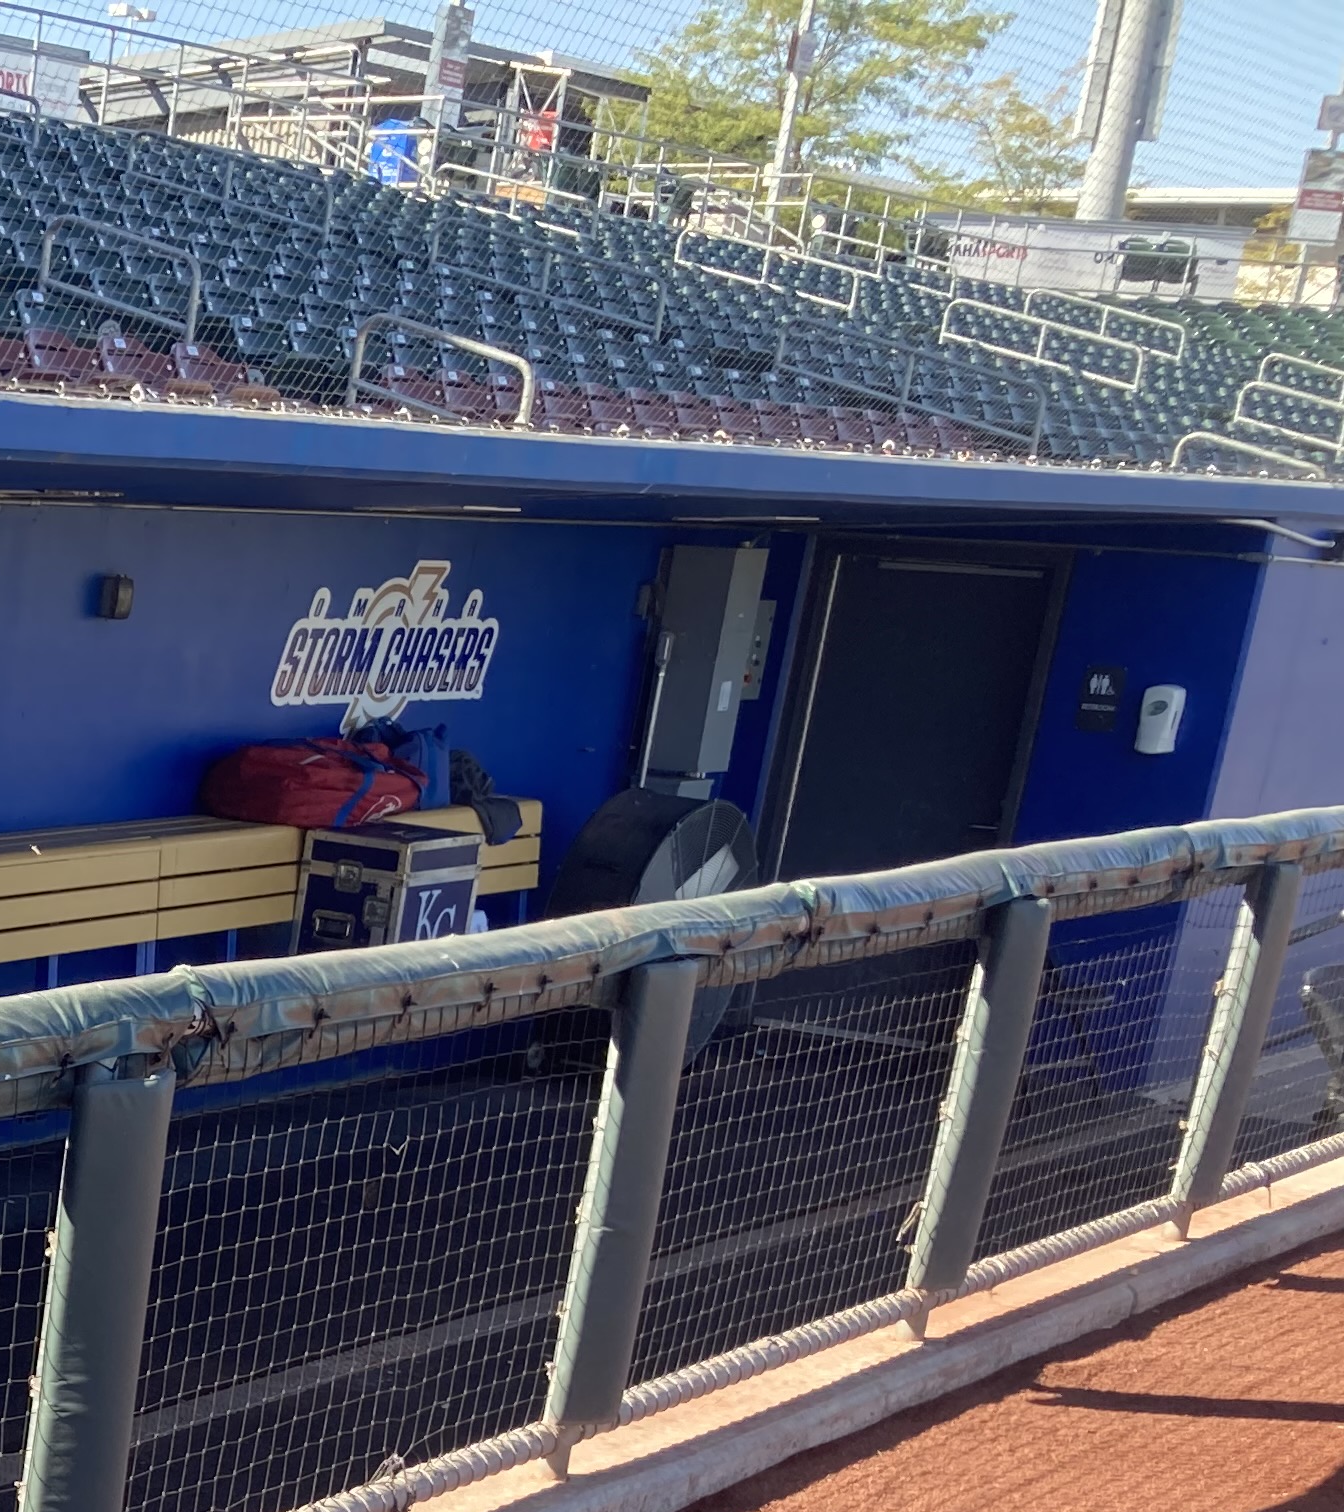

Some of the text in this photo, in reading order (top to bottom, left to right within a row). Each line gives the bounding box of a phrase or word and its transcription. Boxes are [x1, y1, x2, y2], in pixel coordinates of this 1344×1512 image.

[313, 598, 477, 617] OMAHA
[275, 626, 495, 698] STORM CHASERS
